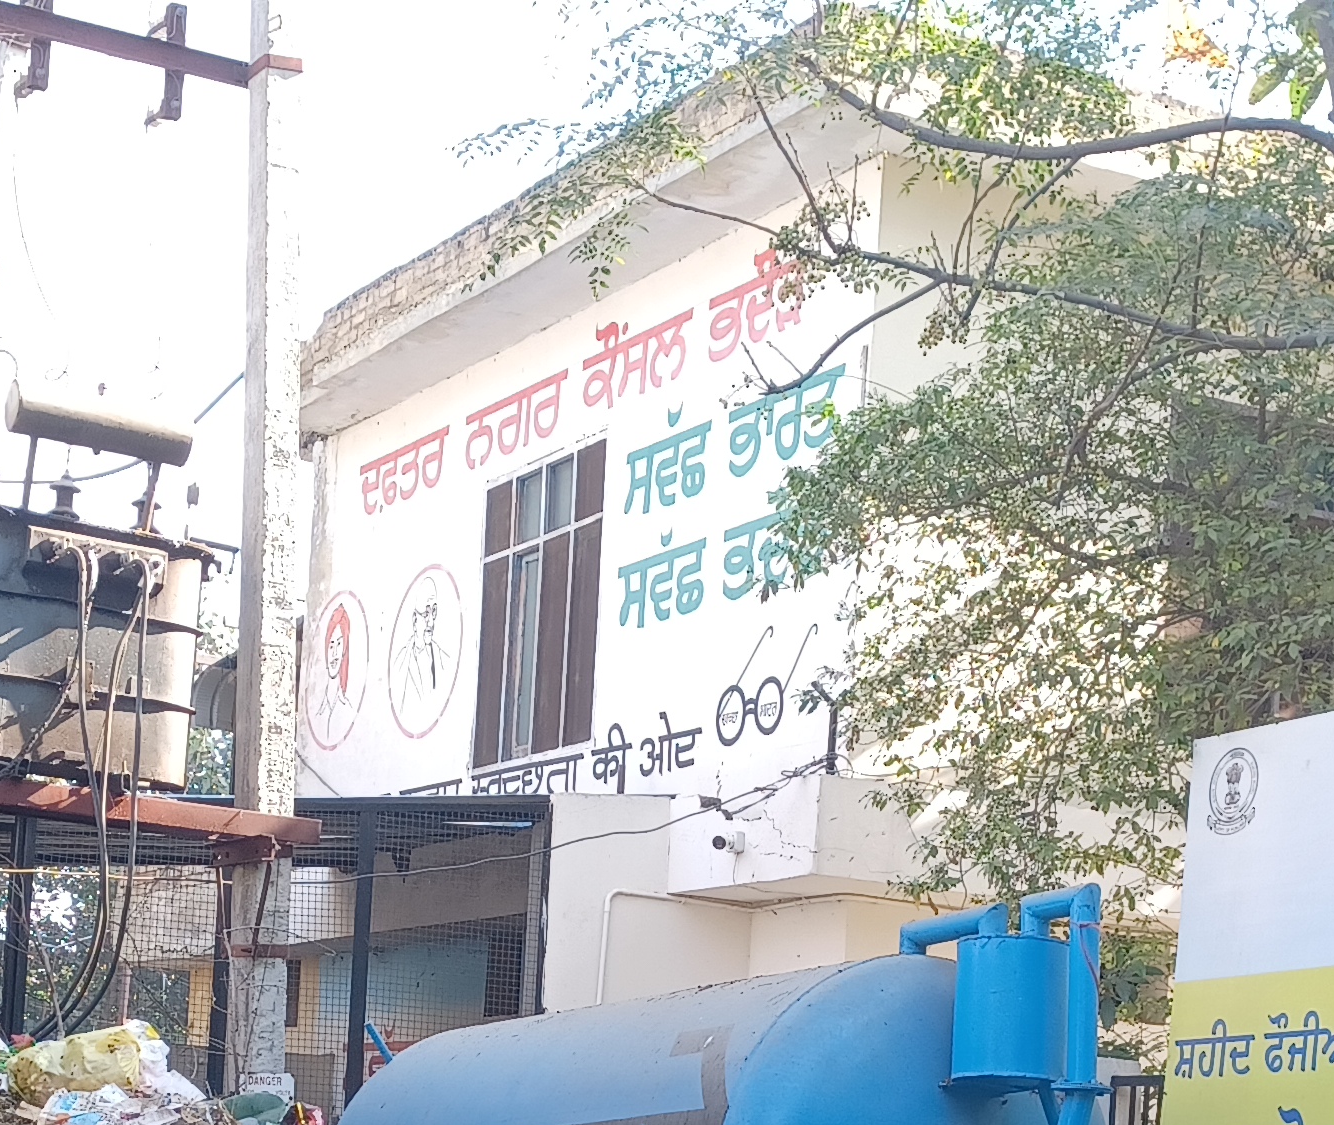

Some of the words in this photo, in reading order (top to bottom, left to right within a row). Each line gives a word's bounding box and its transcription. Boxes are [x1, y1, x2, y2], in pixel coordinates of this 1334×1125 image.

[465, 367, 569, 471] ਨਗਰ
[582, 307, 695, 410] ਕੌਂਸਲ
[623, 401, 713, 515] ਸਵੱਛ
[728, 362, 847, 478] ਭਾਰਤ
[617, 526, 707, 629] ਸਵੱਛ
[592, 722, 633, 795] की
[247, 1075, 283, 1086] DANGER
[1173, 1018, 1256, 1080] ਸ਼ਹੀਦ
